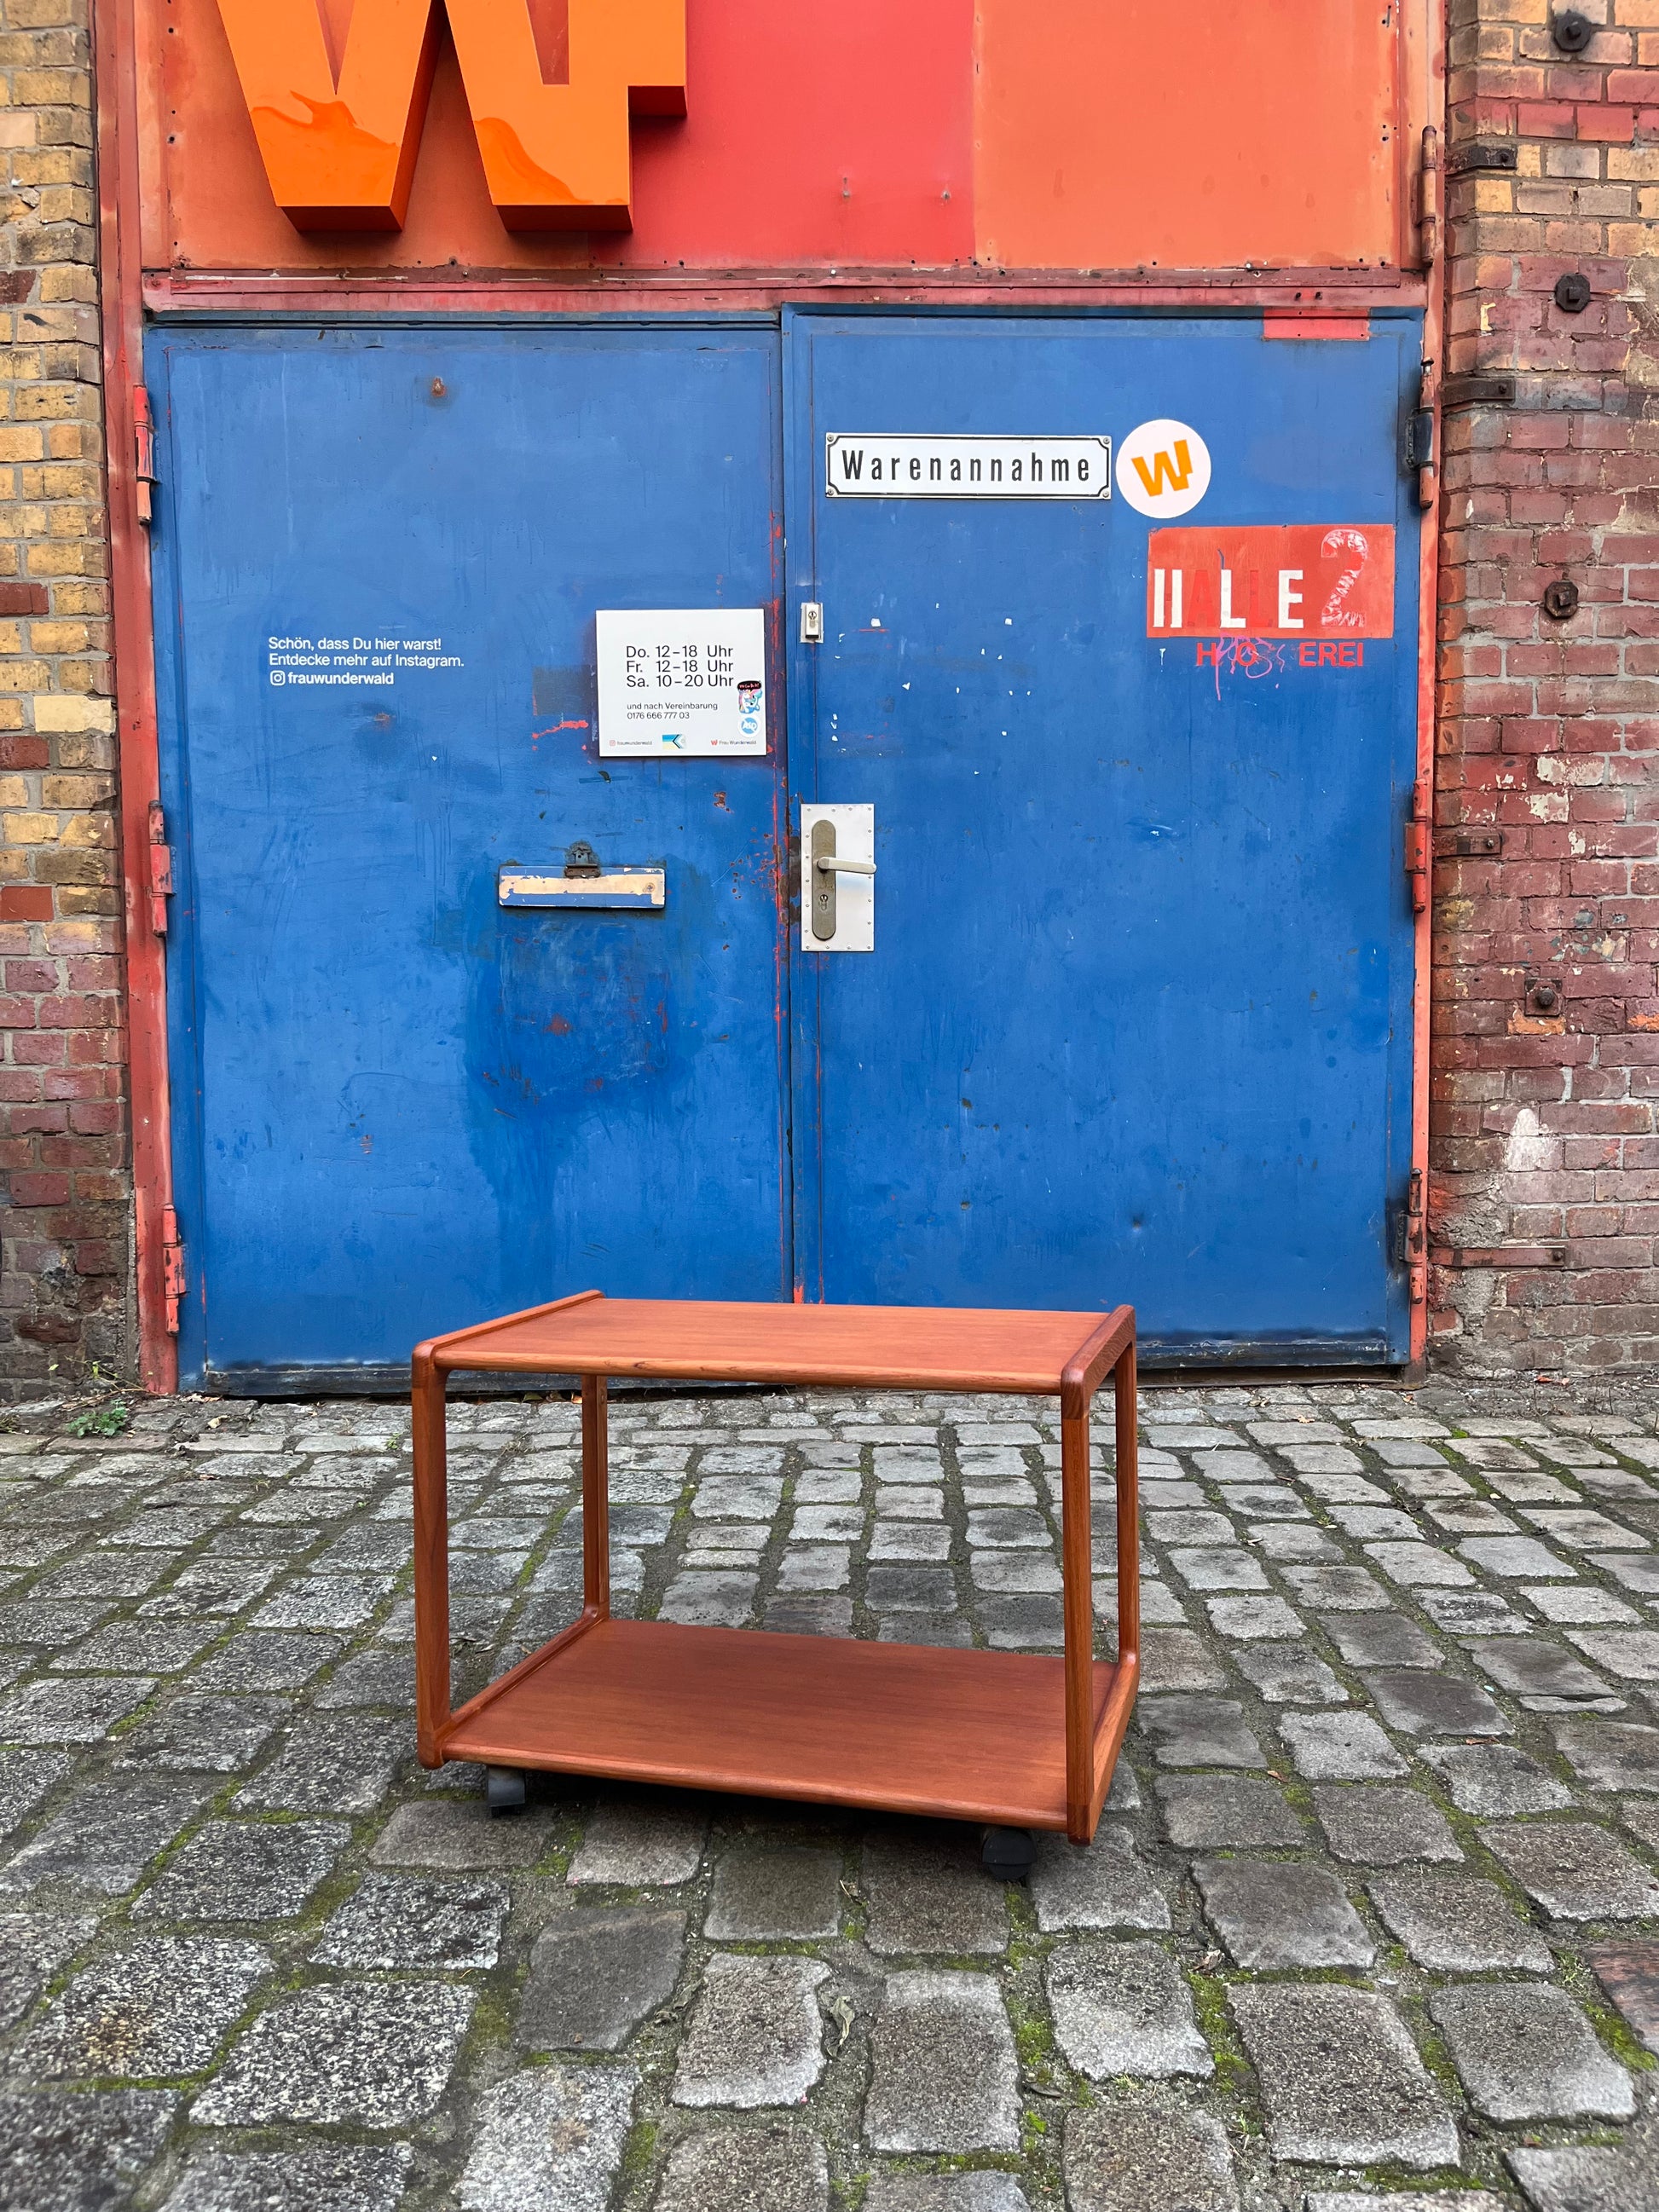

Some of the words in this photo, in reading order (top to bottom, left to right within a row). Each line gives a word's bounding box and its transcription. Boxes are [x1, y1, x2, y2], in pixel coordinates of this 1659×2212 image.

[841, 449, 1090, 482] Warenannahme
[1130, 439, 1193, 497] W
[1321, 528, 1368, 628] 2
[269, 637, 314, 651] Schön,
[317, 637, 350, 650] dass
[353, 638, 372, 650] Du
[375, 638, 400, 650] hier
[402, 638, 442, 650] warst!
[626, 645, 650, 658] Do.
[707, 644, 733, 657] Uhr
[269, 653, 330, 666] Entdecke
[333, 654, 368, 667] mehr
[371, 654, 392, 667] auf
[396, 655, 465, 669] Instagram.
[626, 661, 643, 673] Fr.
[707, 660, 733, 673] Uhr
[288, 672, 394, 685] frauwunderwald
[627, 675, 650, 688] Sa.
[708, 674, 734, 687] Uhr
[665, 702, 718, 711] Vereinbarung
